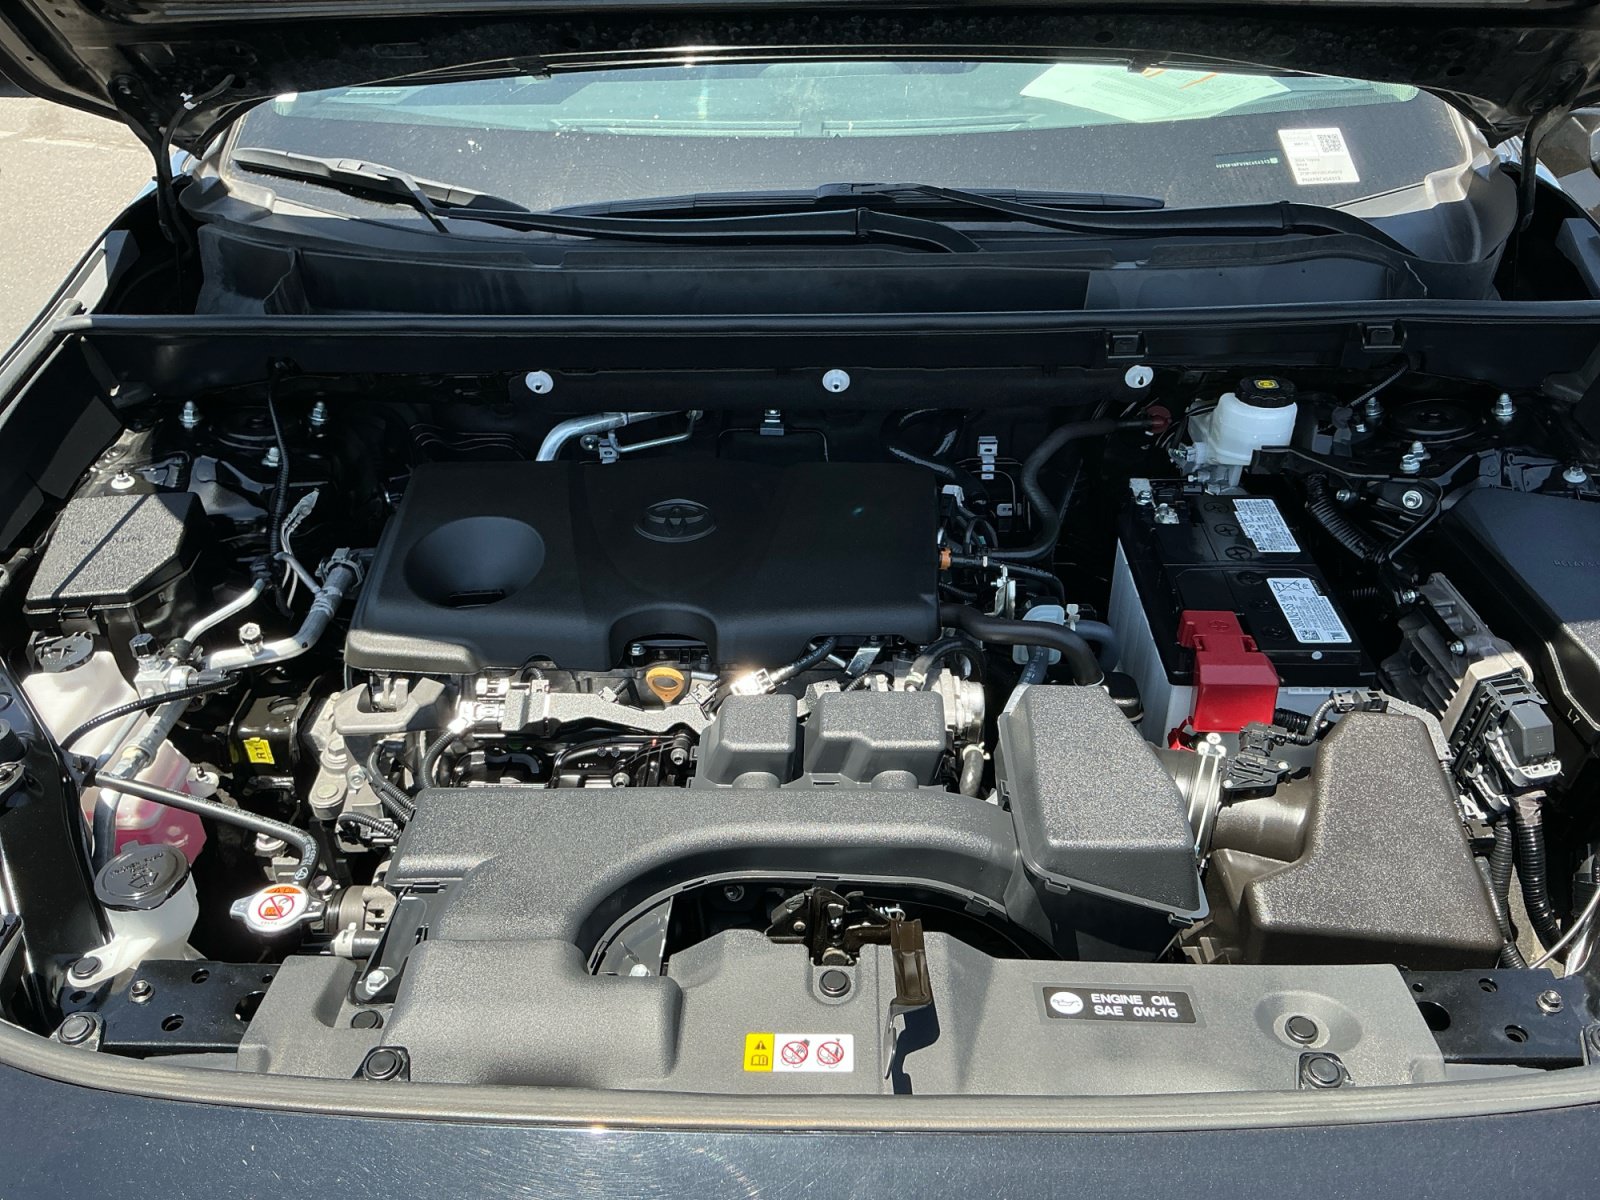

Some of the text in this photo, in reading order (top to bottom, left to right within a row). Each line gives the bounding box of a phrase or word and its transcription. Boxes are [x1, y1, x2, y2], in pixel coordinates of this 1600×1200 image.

[1091, 993, 1176, 1006] ENGINE OIL
[1094, 1005, 1178, 1018] SAE 0W-16
